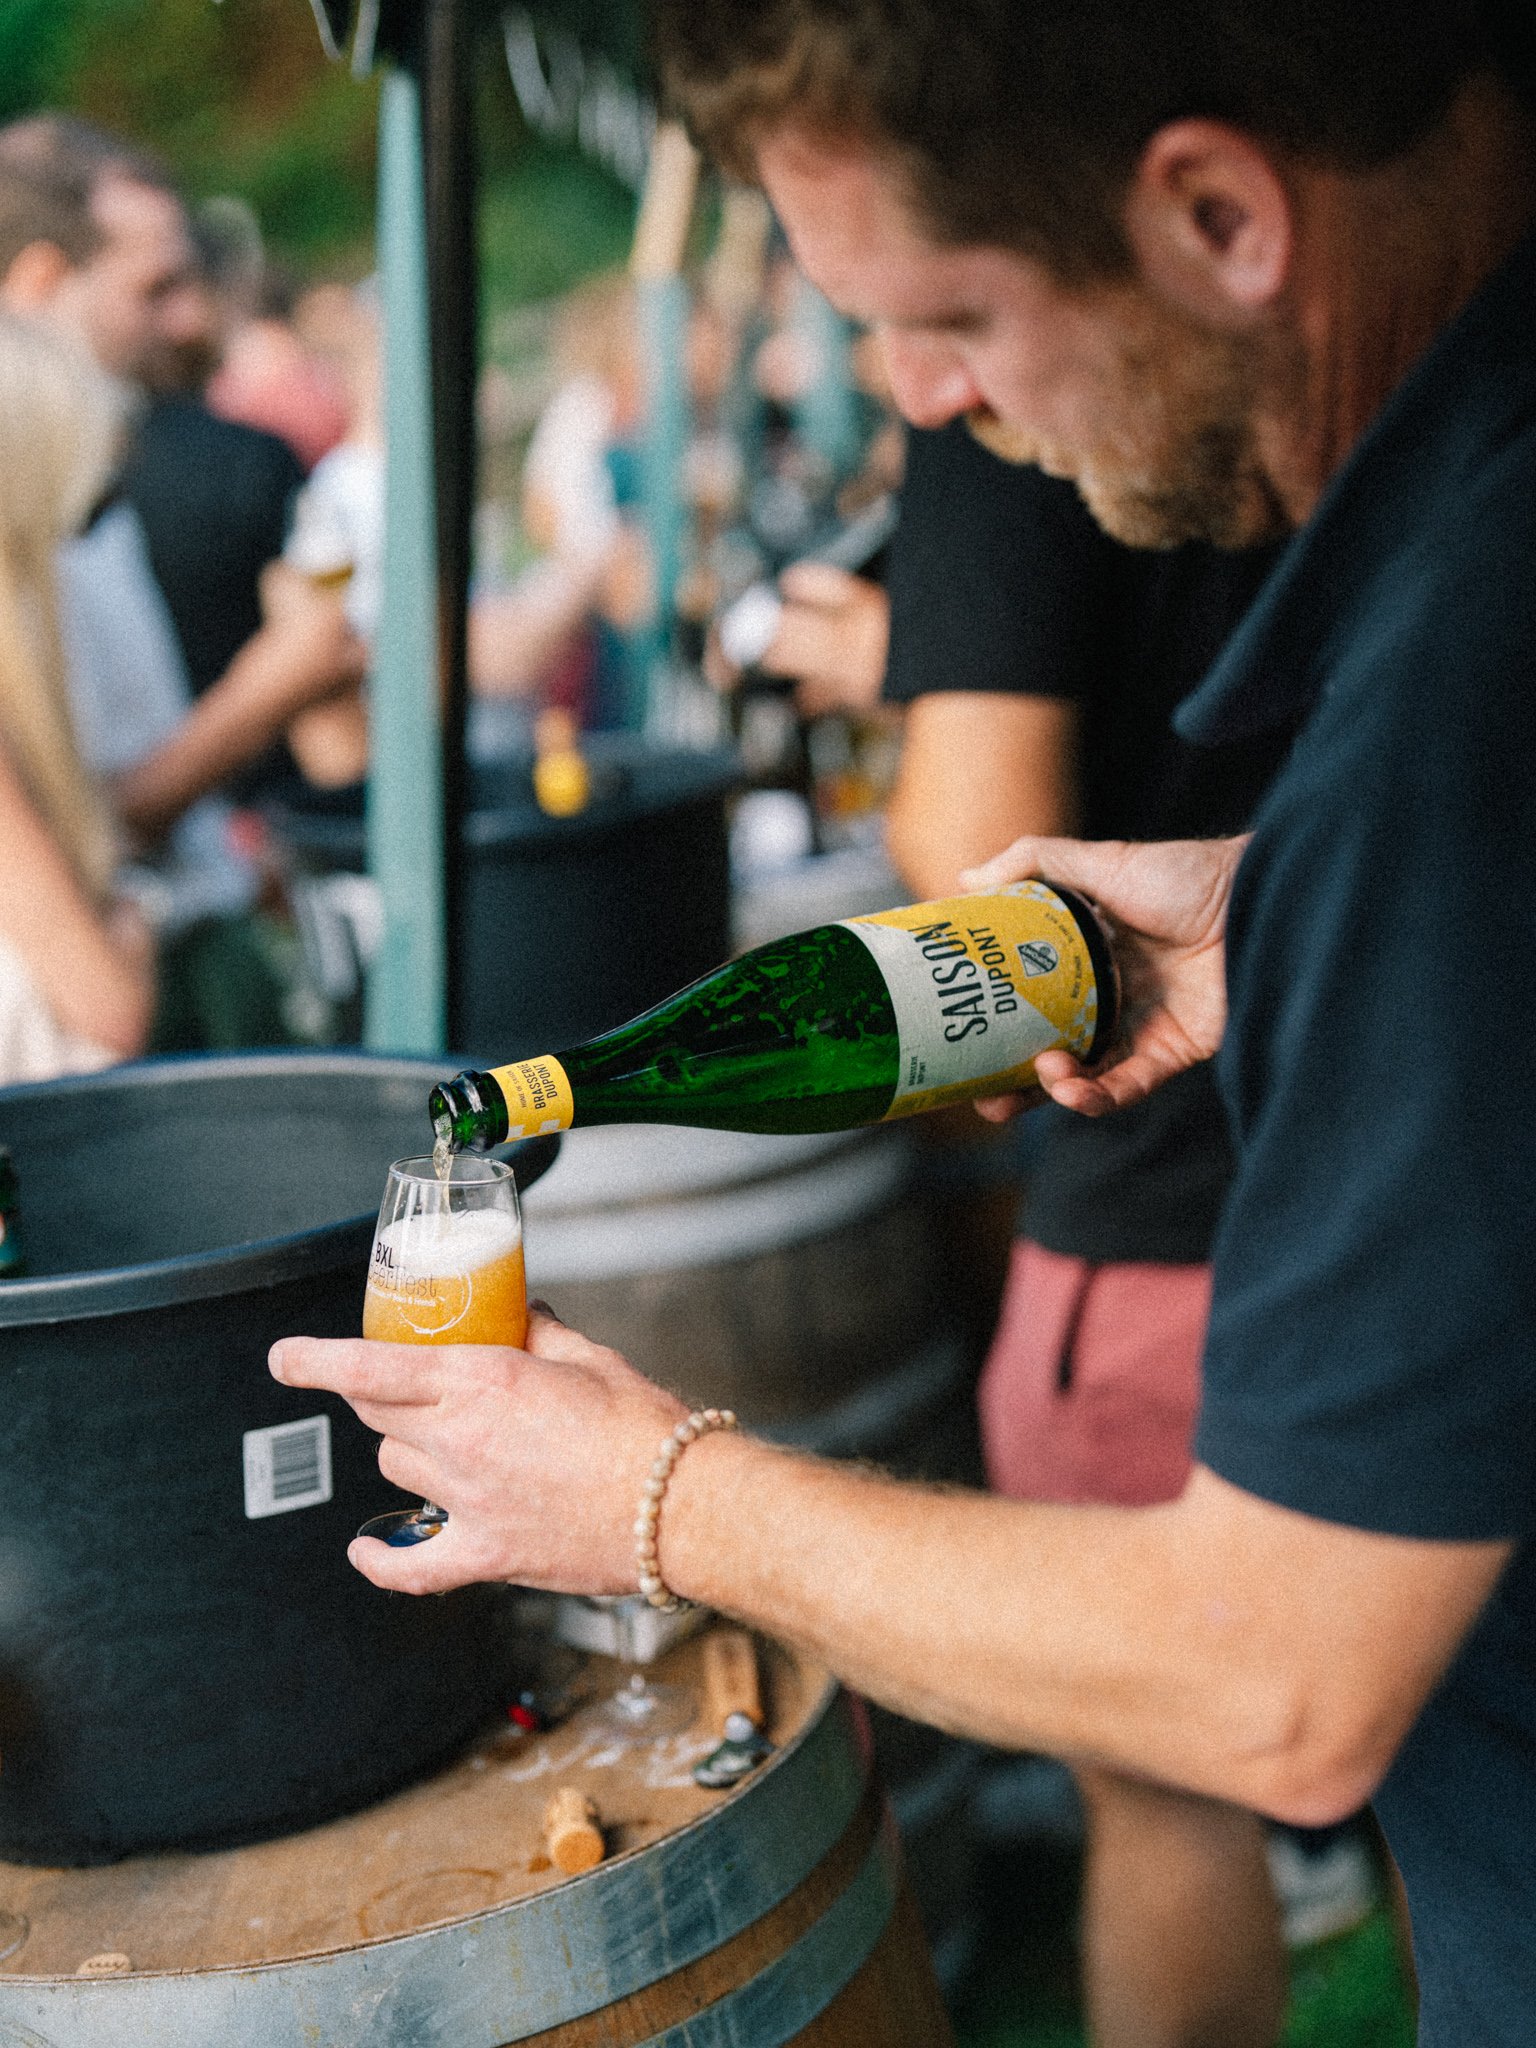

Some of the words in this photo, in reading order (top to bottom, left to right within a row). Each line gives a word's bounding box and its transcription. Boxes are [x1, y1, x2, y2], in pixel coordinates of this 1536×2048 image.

[907, 921, 988, 1043] SAISON
[966, 927, 1018, 1014] DUPONT
[516, 1063, 547, 1110] BRASSERIE
[532, 1063, 558, 1099] DUPONT
[375, 1241, 394, 1269] BXL
